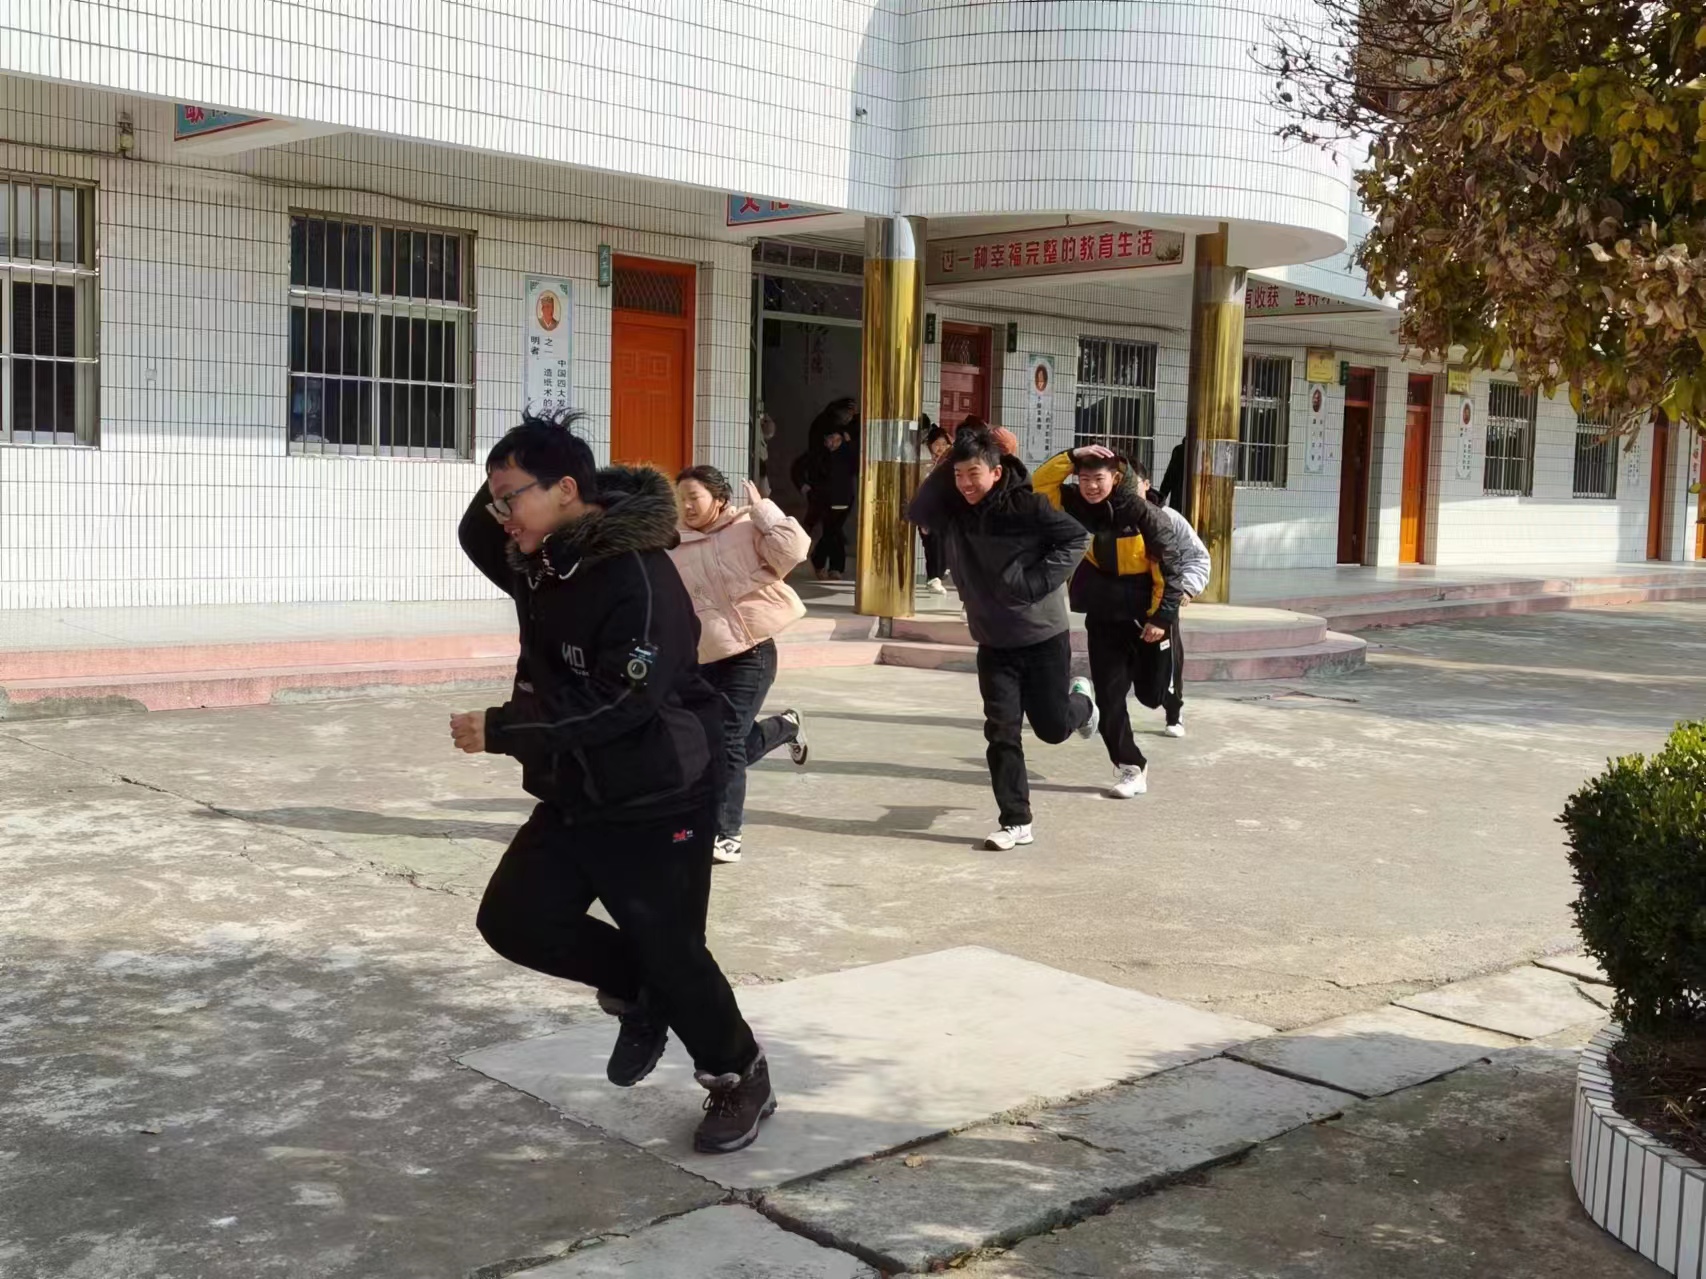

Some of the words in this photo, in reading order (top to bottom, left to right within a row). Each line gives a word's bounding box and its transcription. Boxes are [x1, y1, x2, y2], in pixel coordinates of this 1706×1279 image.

[942, 229, 1156, 273] 过一种幸福完整的教育生活
